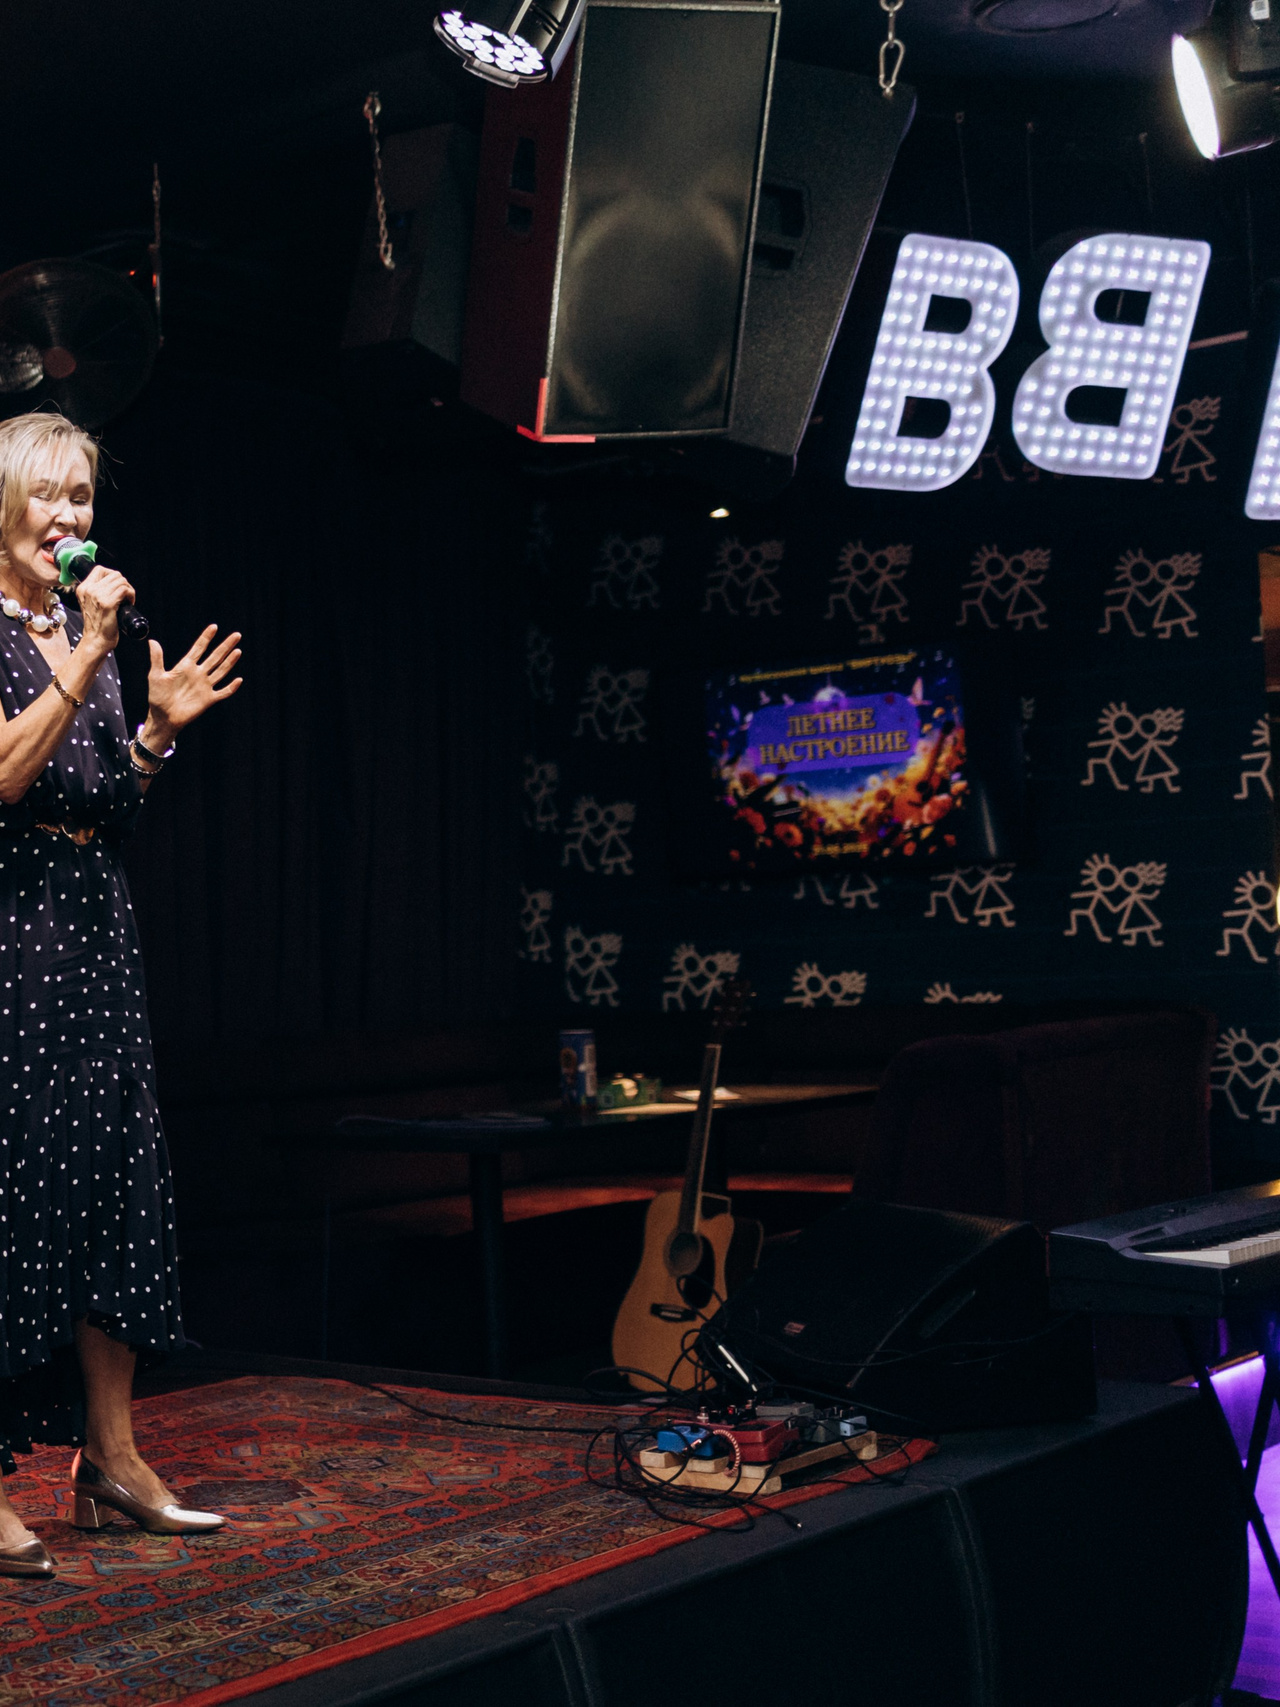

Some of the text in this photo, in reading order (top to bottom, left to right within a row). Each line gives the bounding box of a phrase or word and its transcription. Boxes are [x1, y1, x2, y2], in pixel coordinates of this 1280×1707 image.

[844, 233, 1280, 521] ВВ
[786, 707, 876, 737] ЛЕТНЕЕ
[759, 730, 911, 765] НАСТРОЕНИЕ
